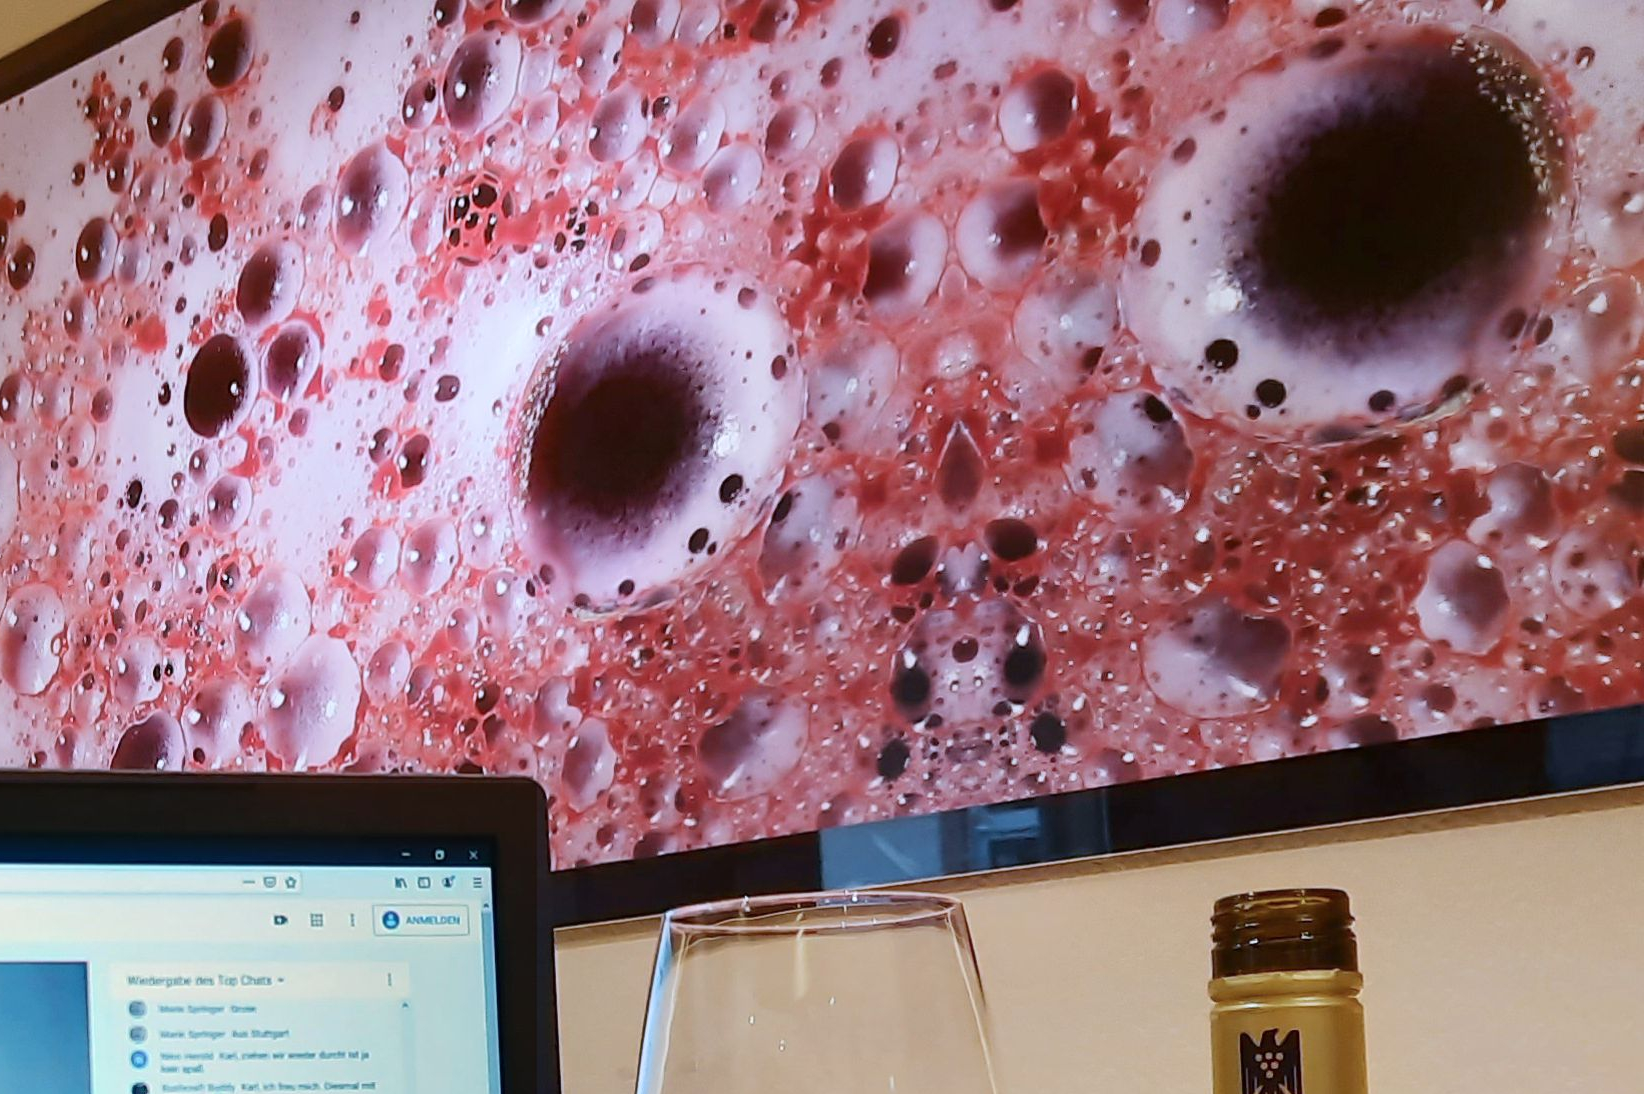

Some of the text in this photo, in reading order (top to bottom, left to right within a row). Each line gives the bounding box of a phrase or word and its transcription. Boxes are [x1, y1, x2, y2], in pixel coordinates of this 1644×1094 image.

[406, 914, 460, 926] ANMELDEN
[128, 975, 271, 988] Wiedergabe des Top Chats
